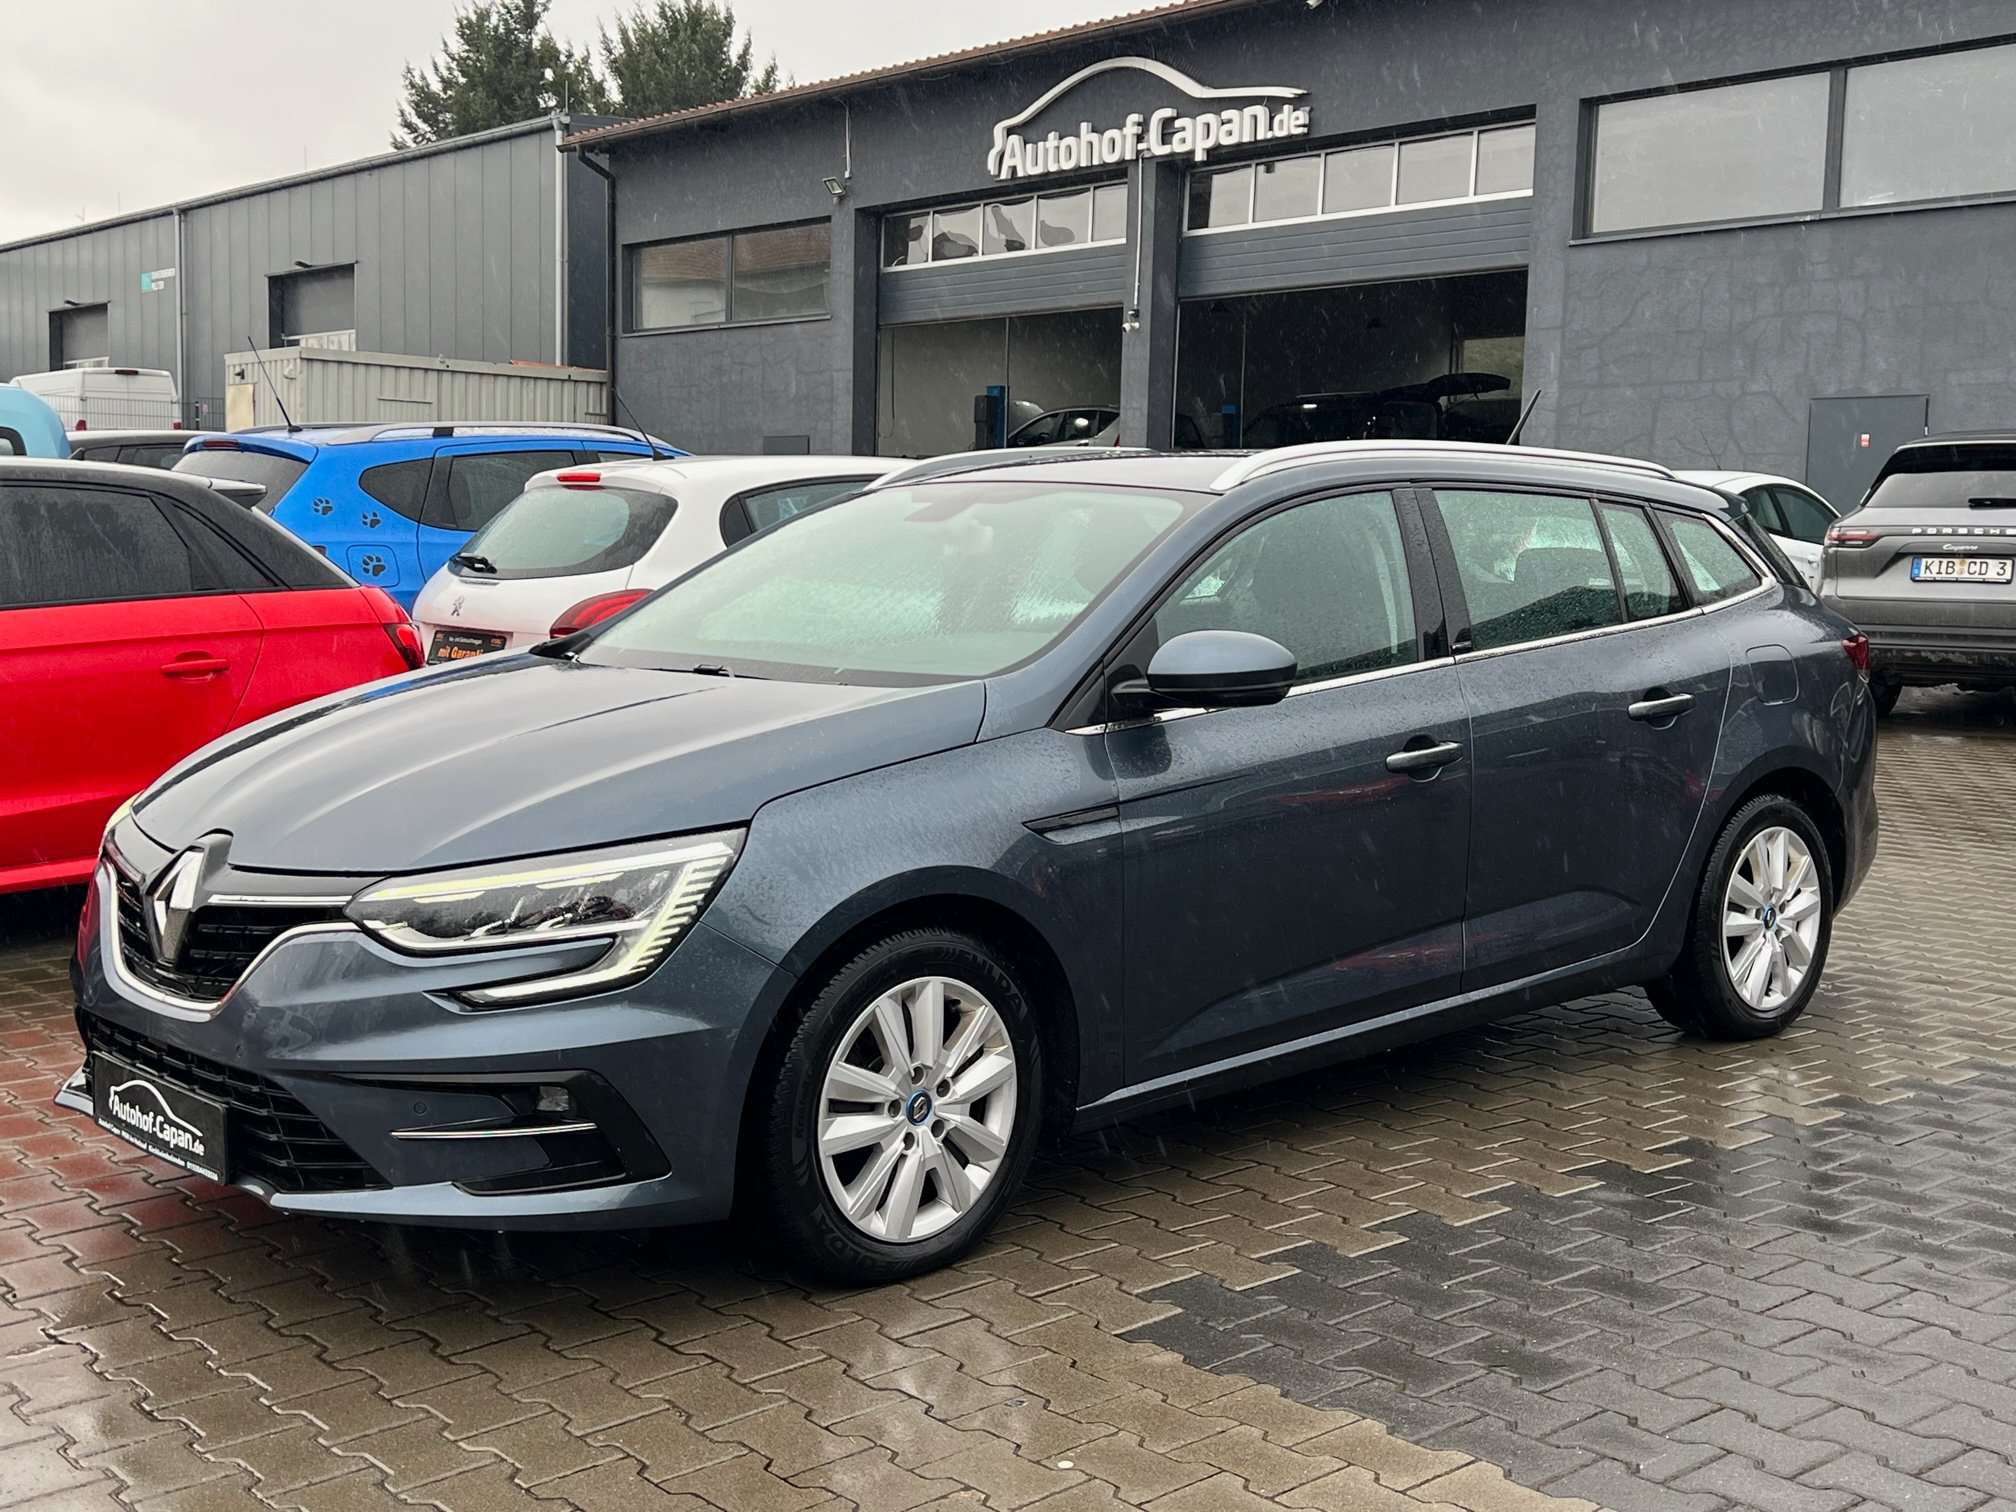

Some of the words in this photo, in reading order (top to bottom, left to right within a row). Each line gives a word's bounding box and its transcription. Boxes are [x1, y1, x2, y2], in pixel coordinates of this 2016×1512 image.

[1923, 559, 1956, 576] KIB
[1967, 560, 1989, 576] CD
[1996, 561, 2008, 577] 3
